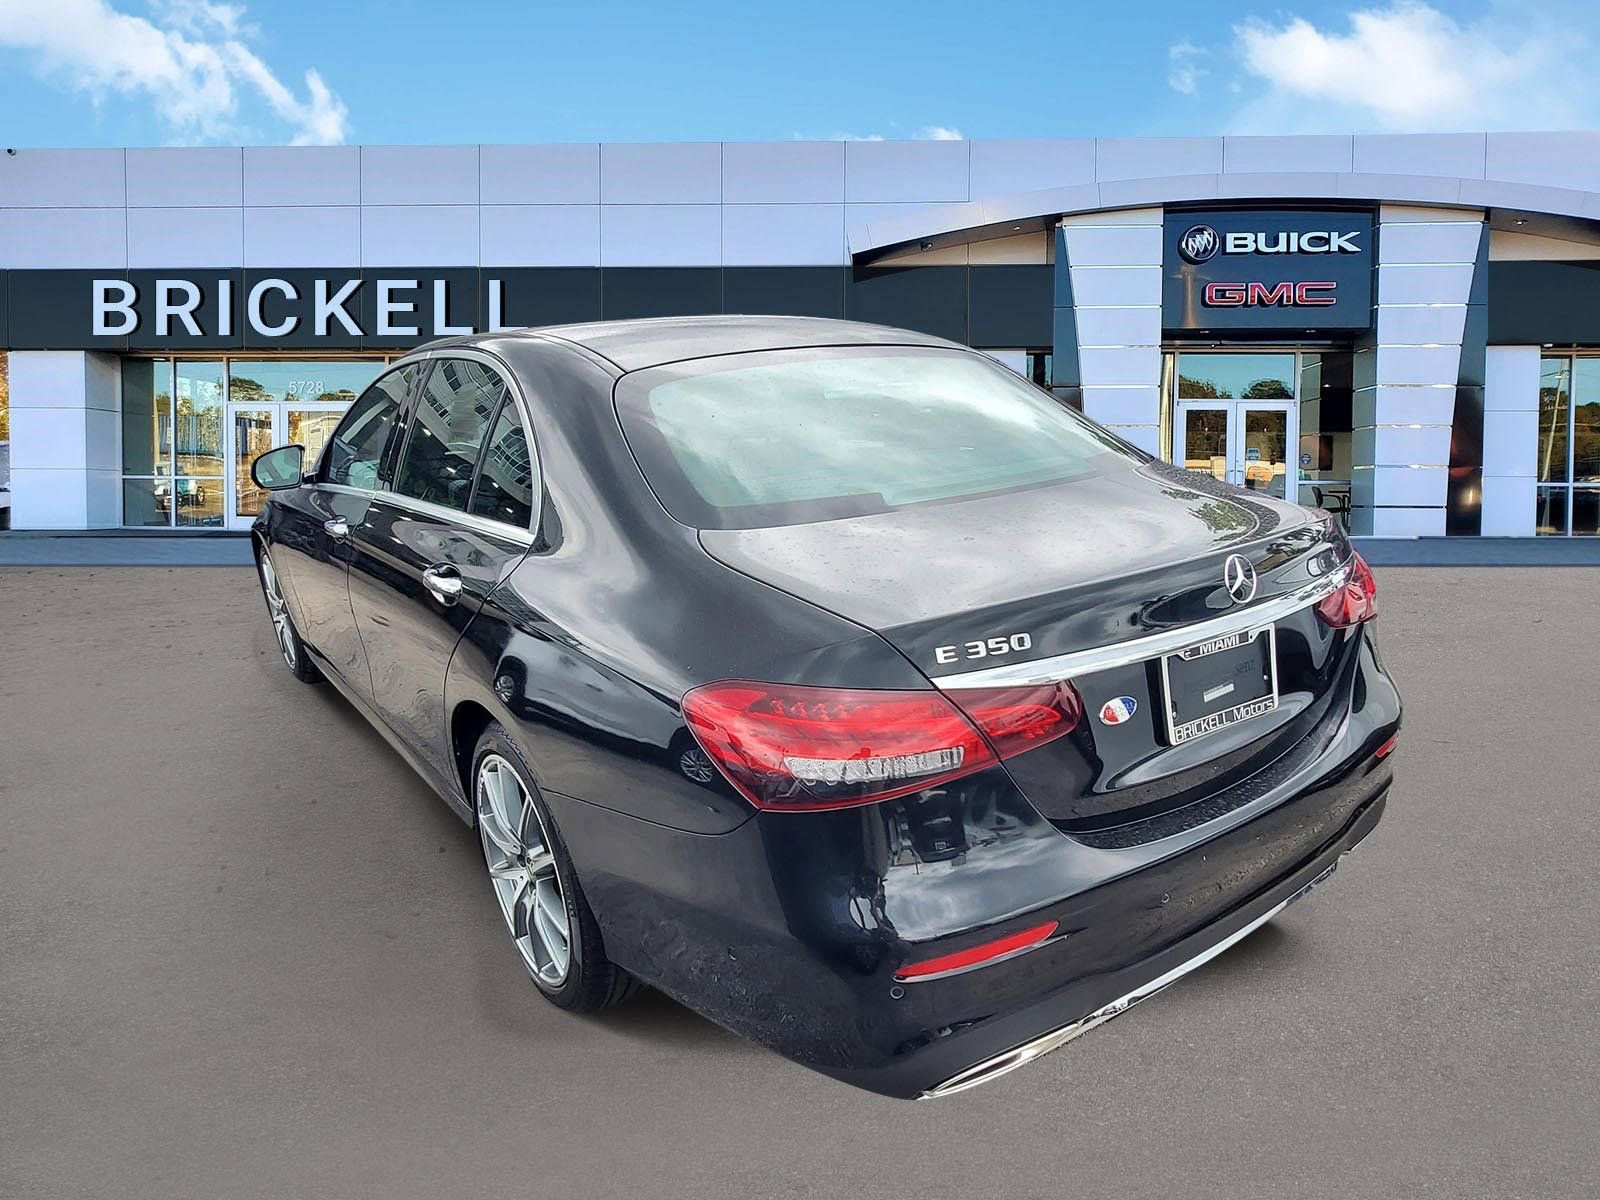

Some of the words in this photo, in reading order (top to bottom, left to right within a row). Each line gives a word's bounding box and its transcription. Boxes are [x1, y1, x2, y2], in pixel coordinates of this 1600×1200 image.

[1226, 231, 1362, 253] BUICK
[1206, 282, 1337, 305] GMC
[92, 278, 529, 336] BRICKELL
[289, 381, 325, 394] 5728
[935, 645, 959, 664] E
[964, 632, 1032, 659] 350
[1199, 634, 1240, 655] MIAMI
[1174, 712, 1230, 743] BRICKELL
[1232, 699, 1274, 721] Motors
